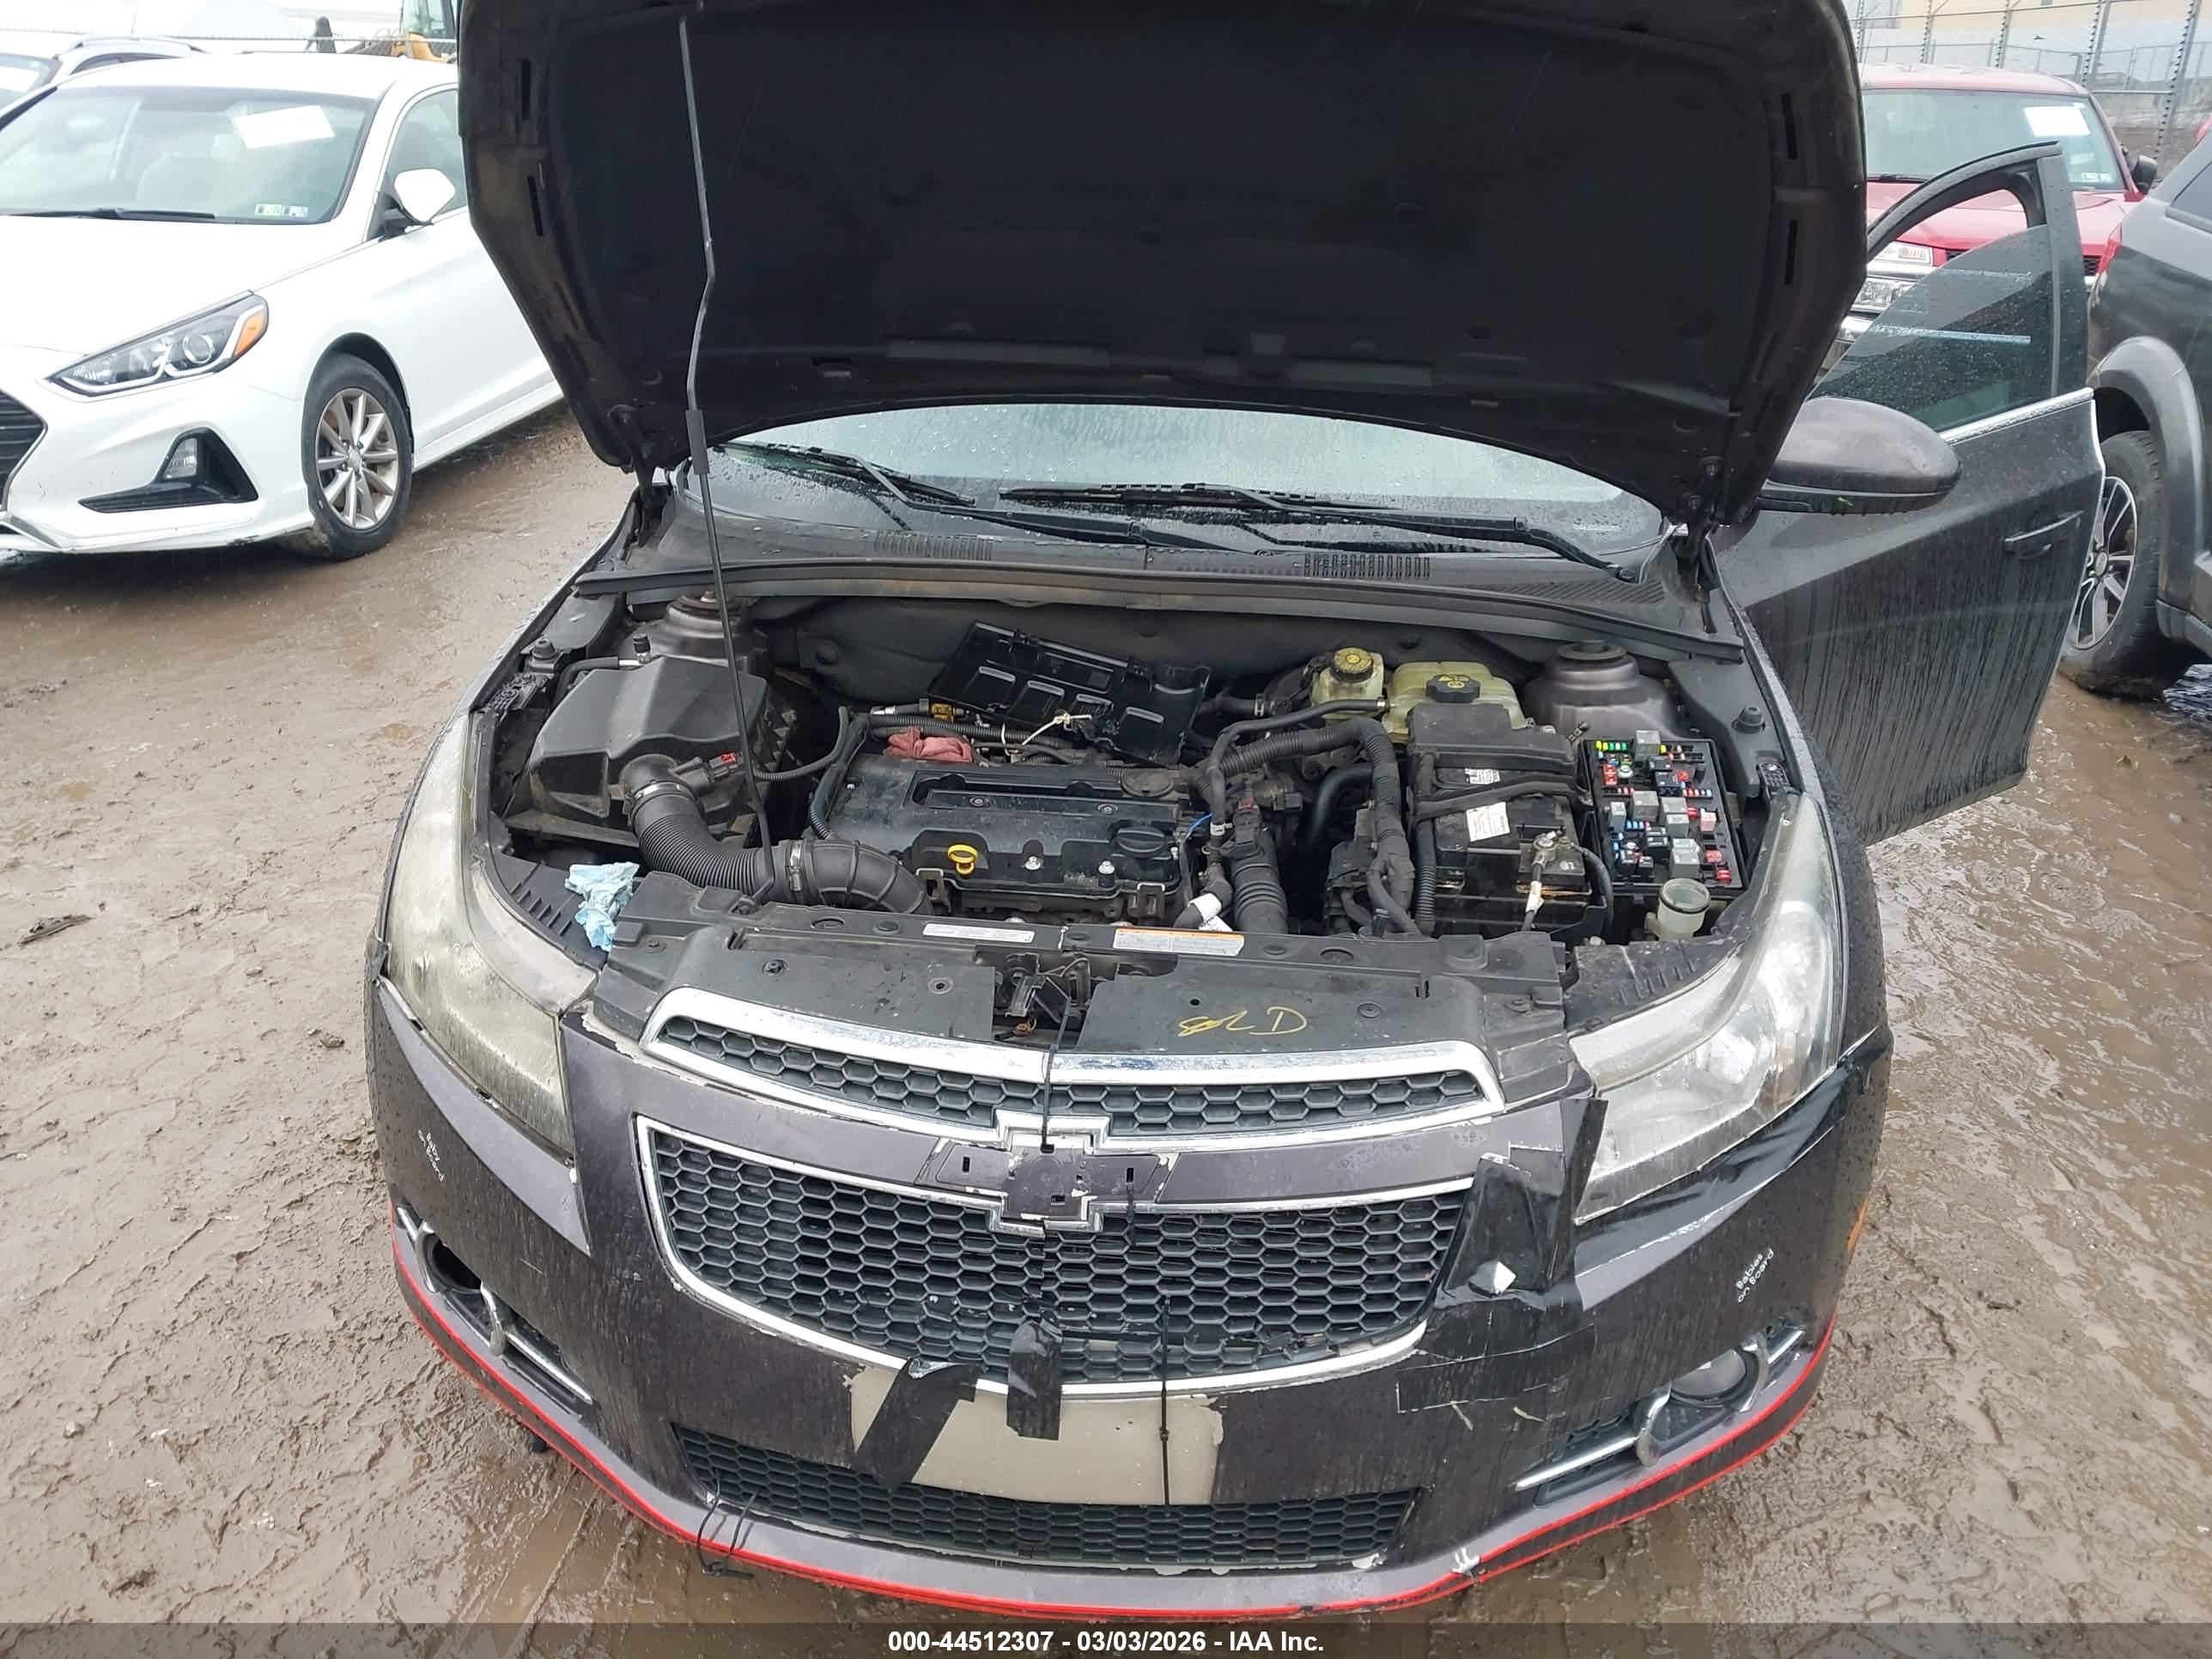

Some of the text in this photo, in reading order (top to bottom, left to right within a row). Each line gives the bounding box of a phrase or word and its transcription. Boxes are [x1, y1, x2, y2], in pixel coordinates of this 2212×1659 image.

[418, 1129, 445, 1182] on Board
[426, 1132, 441, 1161] Baby
[1736, 1254, 1764, 1290] Babies
[1737, 1247, 1774, 1303] on Board
